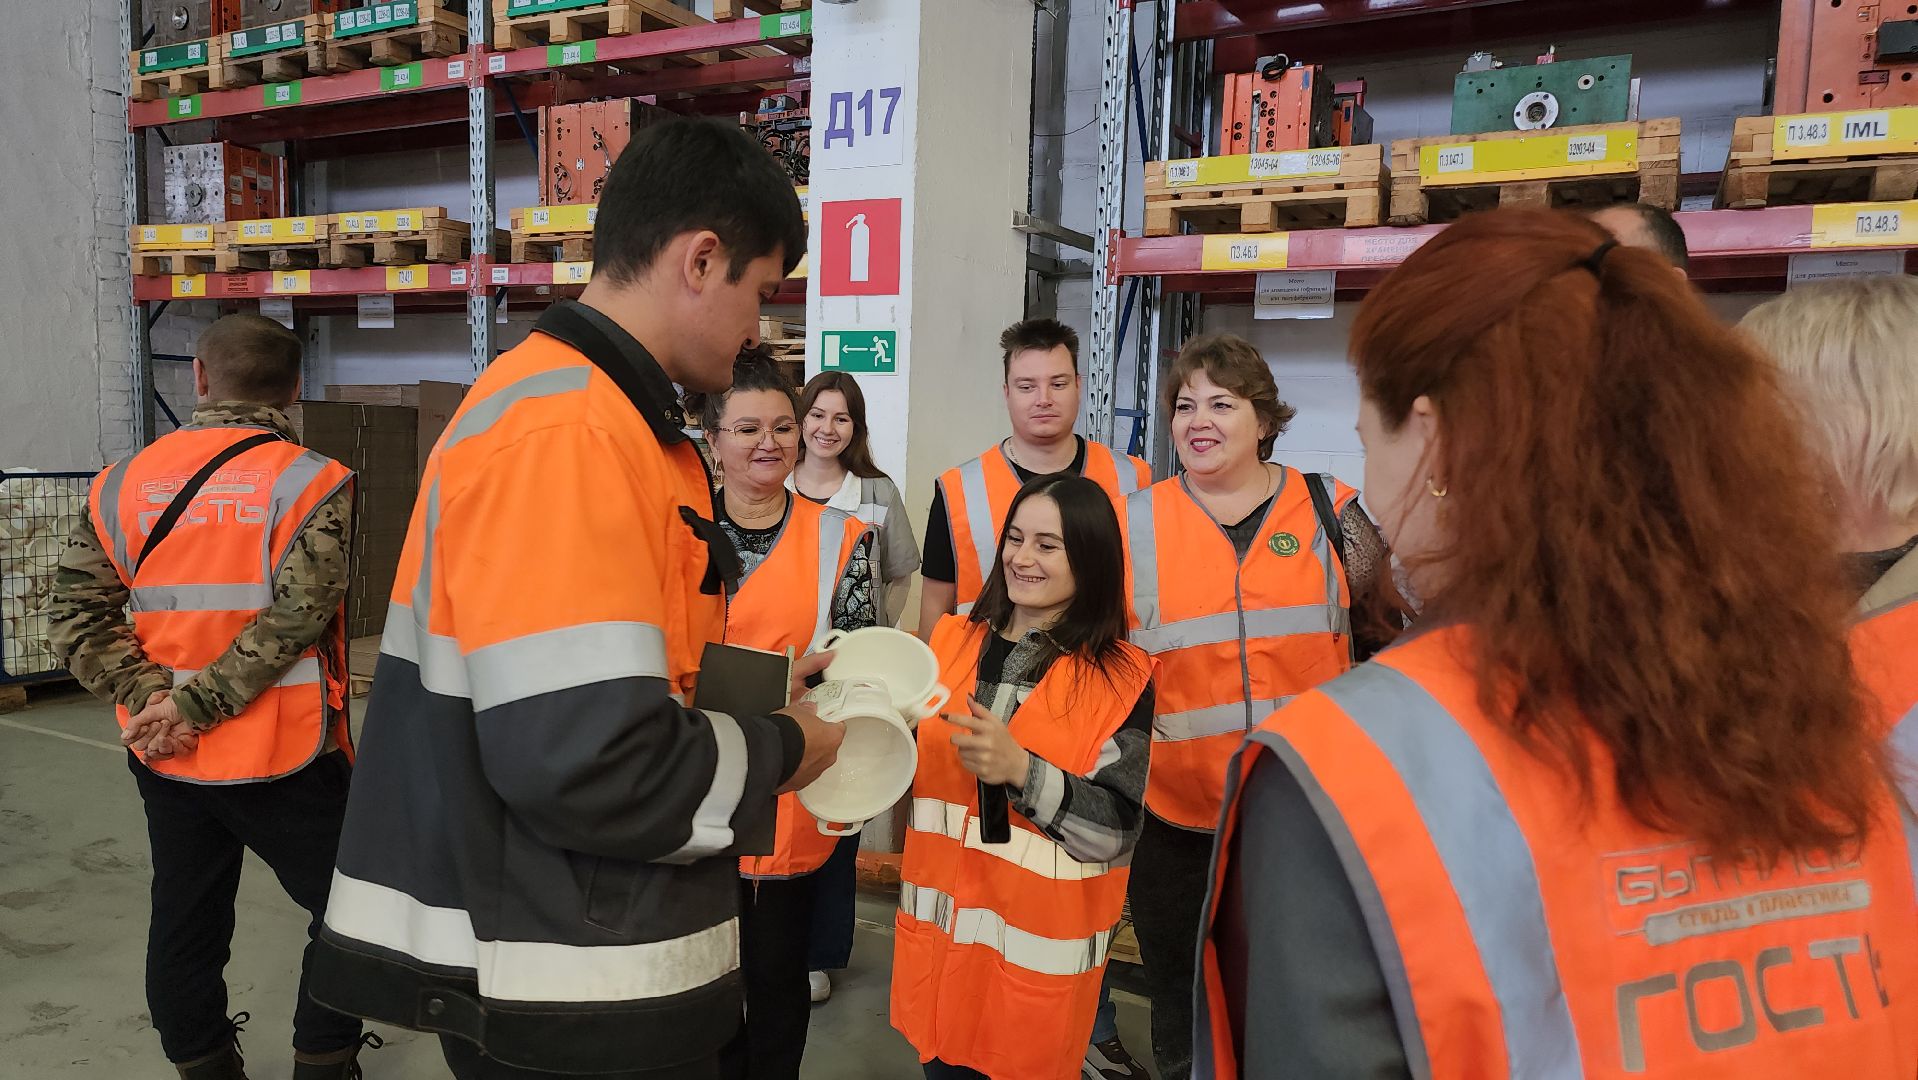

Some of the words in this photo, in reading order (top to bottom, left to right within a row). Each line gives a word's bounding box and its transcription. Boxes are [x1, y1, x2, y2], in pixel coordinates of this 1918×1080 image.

[824, 87, 902, 149] Д17
[1845, 121, 1886, 139] IML
[1856, 214, 1899, 233] П3.48.3
[1230, 245, 1258, 260] П3.46.3
